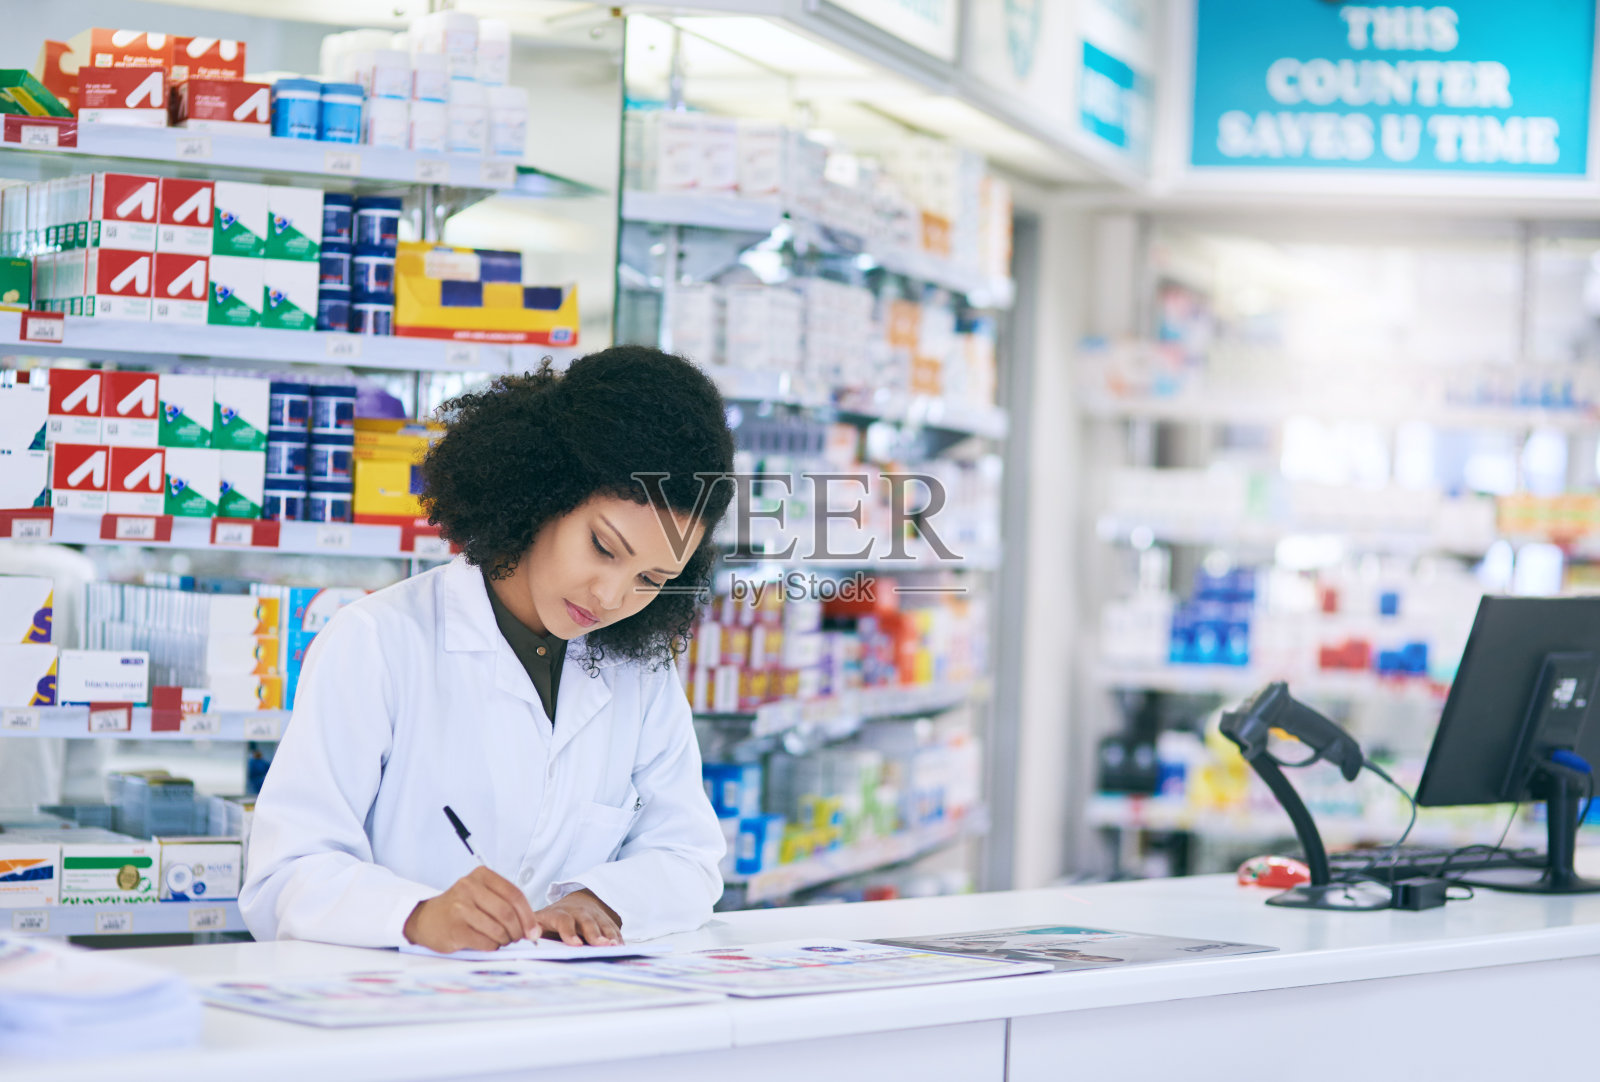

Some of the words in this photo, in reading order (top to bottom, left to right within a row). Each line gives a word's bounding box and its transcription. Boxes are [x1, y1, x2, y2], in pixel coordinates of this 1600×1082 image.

[1340, 6, 1459, 51] THIS
[1266, 58, 1512, 108] COUNTER
[1217, 110, 1374, 161] SAVES
[1381, 114, 1421, 161] U
[1427, 115, 1560, 164] TIME
[84, 680, 143, 689] blackcurrant
